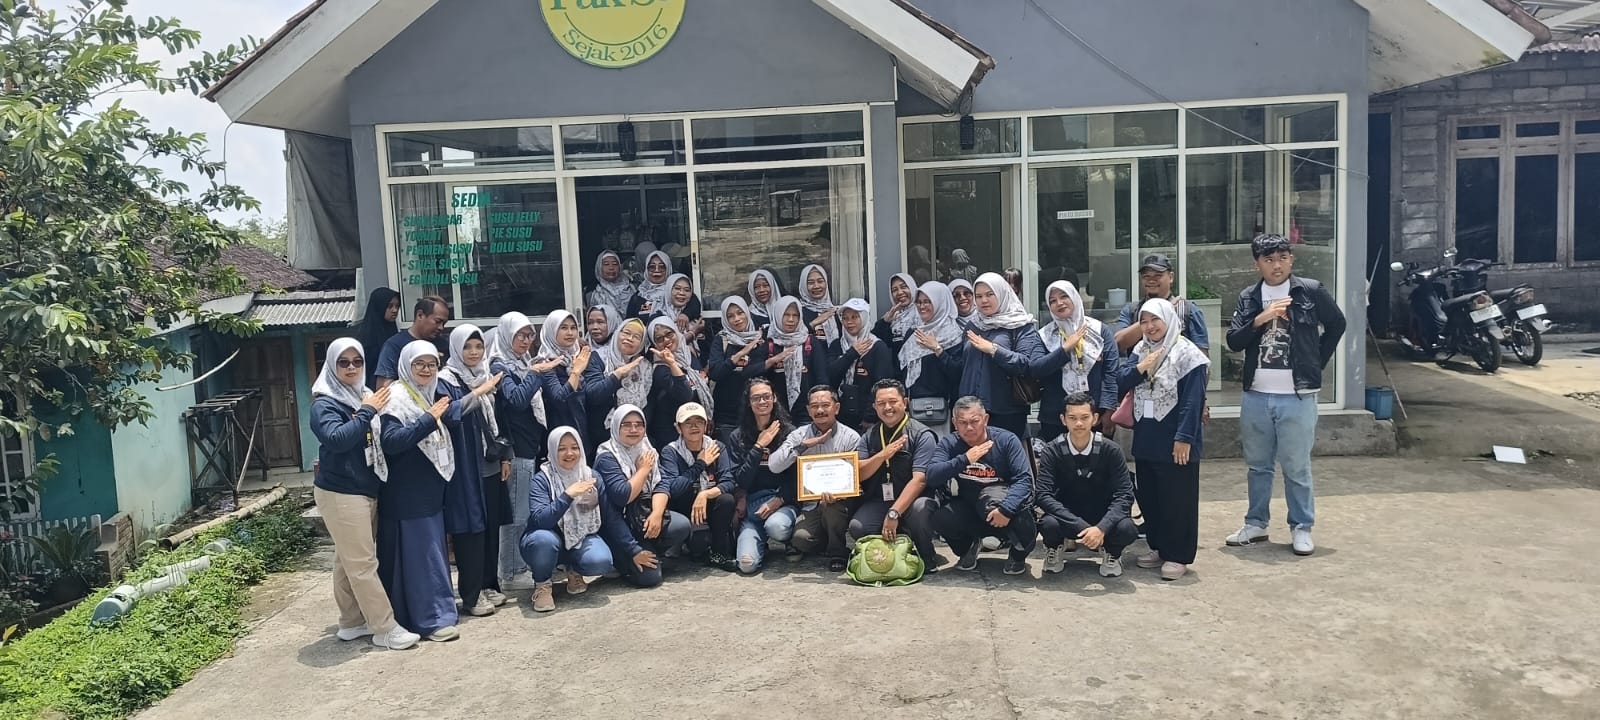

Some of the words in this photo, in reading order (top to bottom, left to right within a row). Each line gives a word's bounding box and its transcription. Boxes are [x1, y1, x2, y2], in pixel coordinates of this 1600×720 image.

[562, 29, 618, 61] Sejak
[621, 24, 668, 60] 2016
[451, 192, 491, 207] SED
[490, 227, 504, 239] PIE
[506, 226, 533, 239] SUSU
[448, 243, 473, 254] SUSU
[490, 241, 515, 253] BOLU
[516, 240, 544, 252] SUSU
[439, 258, 465, 269] SUSU
[452, 272, 479, 285] SUSU
